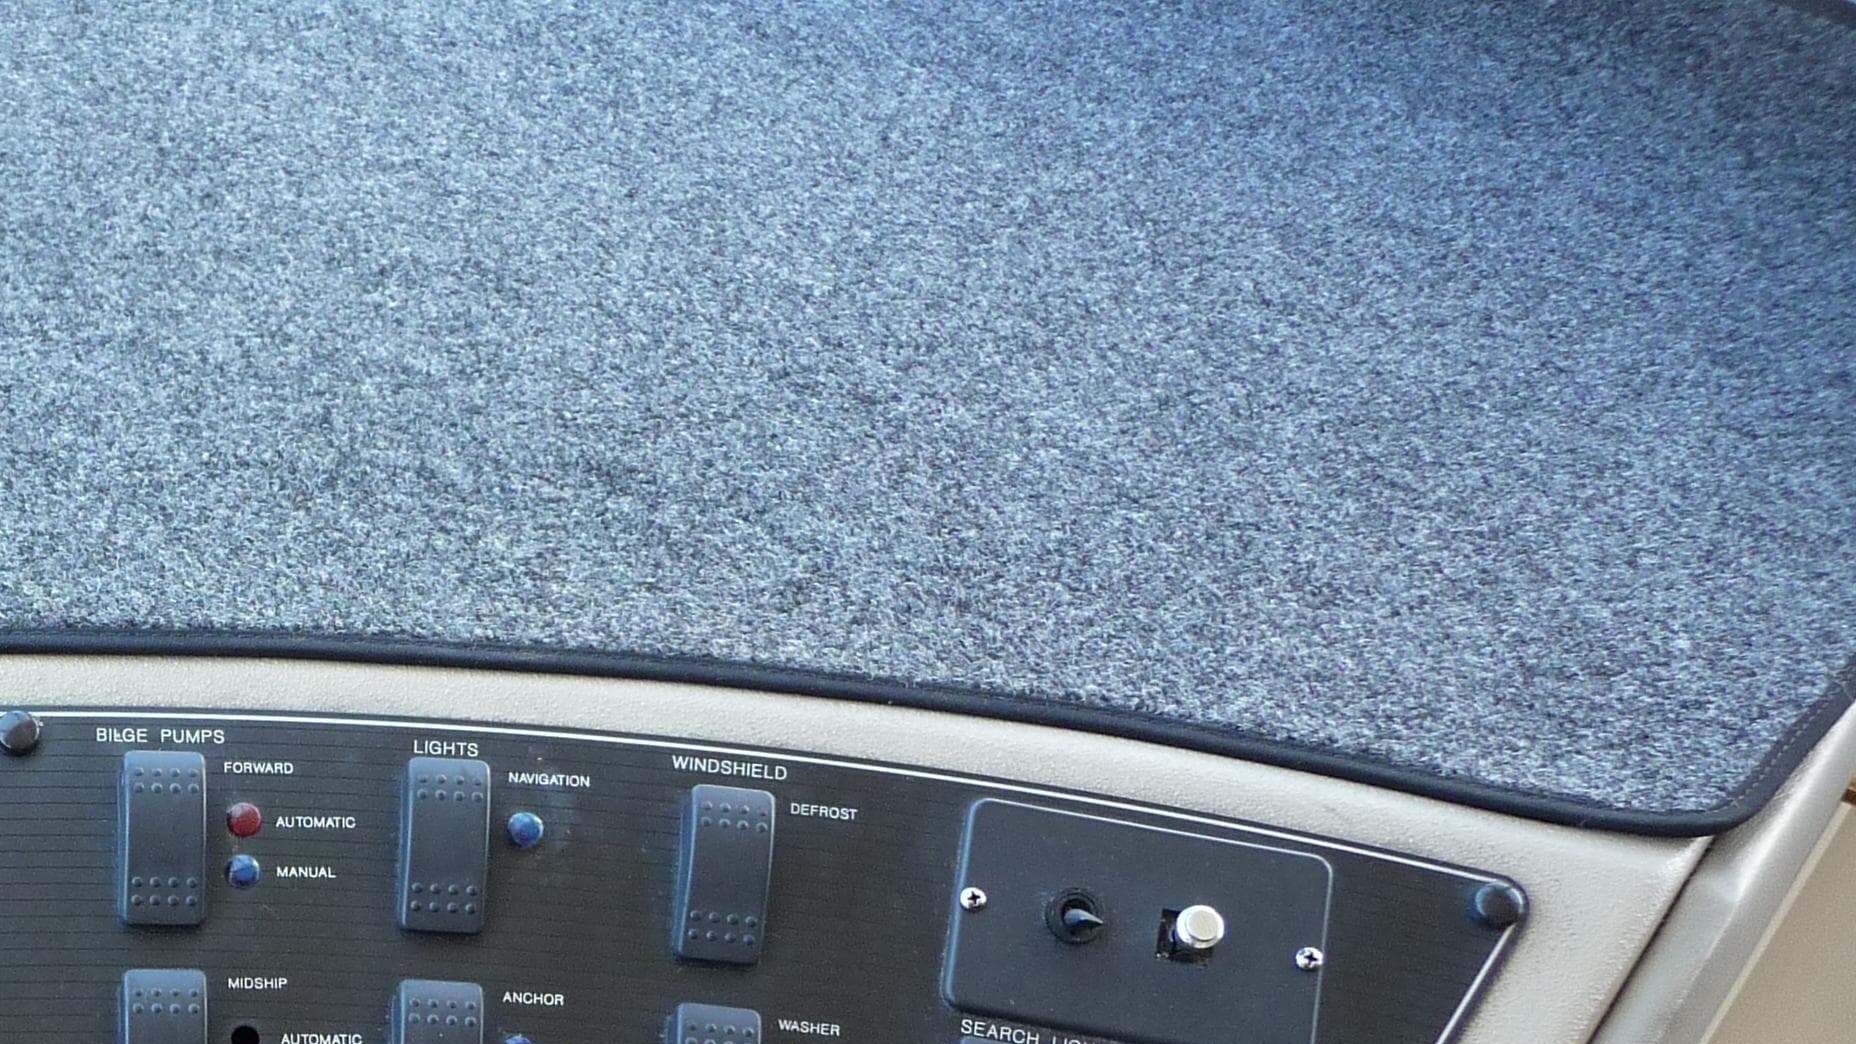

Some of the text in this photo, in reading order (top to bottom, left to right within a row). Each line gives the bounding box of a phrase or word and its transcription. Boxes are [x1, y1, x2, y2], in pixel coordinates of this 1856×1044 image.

[95, 727, 226, 746] BILGE PUMPS
[413, 739, 480, 757] LIGHTS
[223, 761, 294, 775] FORWARD
[672, 755, 788, 781] WINDSHIELD
[508, 772, 591, 789] NAVIGATION
[790, 803, 858, 821] DEFROST
[275, 815, 357, 830] AUTOMATIC
[276, 866, 337, 879] MANUAL
[227, 977, 288, 991] MIDSHIP
[503, 992, 565, 1007] ANCHOR
[778, 1020, 841, 1037] WASHER
